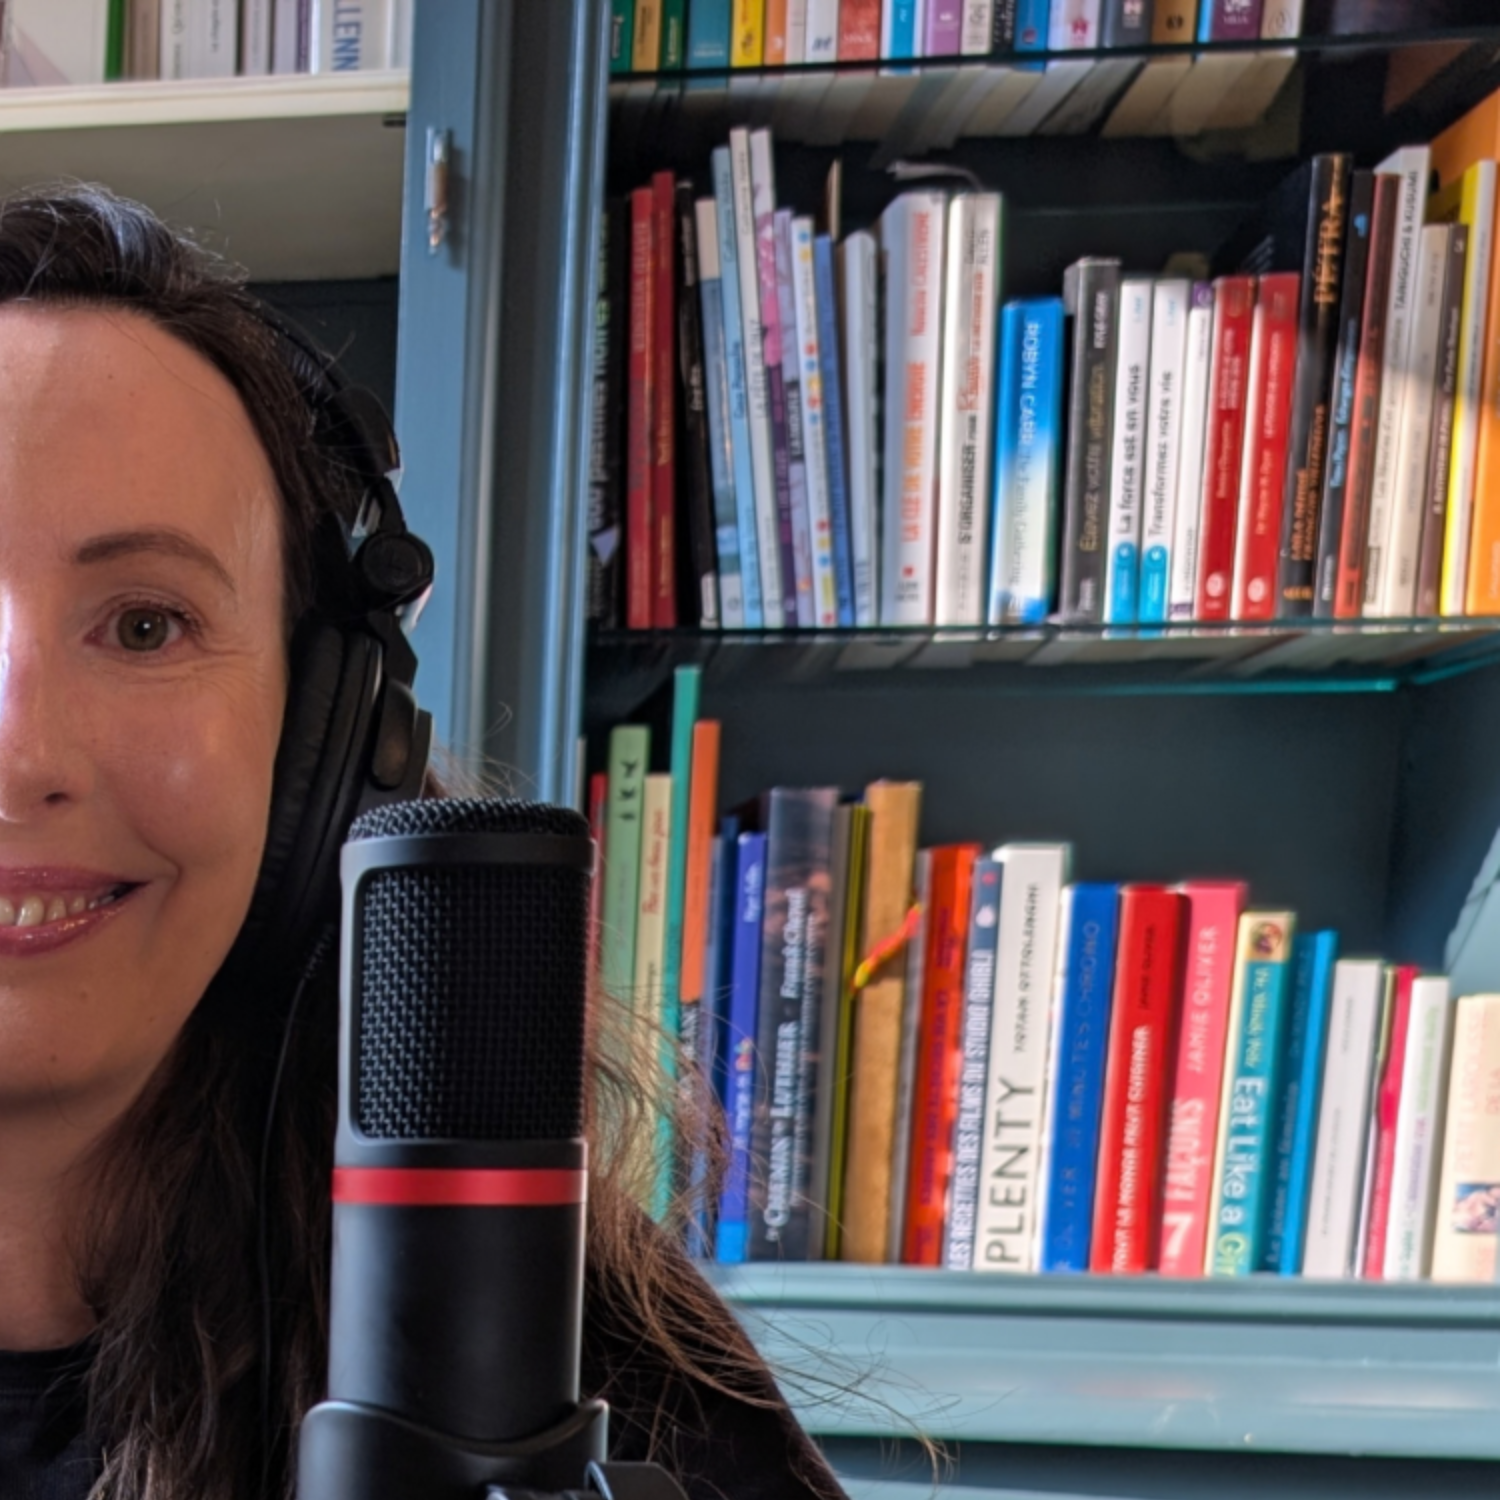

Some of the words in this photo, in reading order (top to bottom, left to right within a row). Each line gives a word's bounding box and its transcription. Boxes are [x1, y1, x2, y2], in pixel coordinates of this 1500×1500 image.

[1402, 170, 1419, 221] KUSUMI
[1394, 237, 1412, 310] TANIGUCHI
[1020, 322, 1040, 387] ROBYN
[1085, 366, 1105, 438] vibration
[1127, 364, 1138, 403] vous
[1157, 371, 1171, 393] vie
[1017, 394, 1037, 445] CARR
[1126, 409, 1137, 430] en
[1157, 398, 1170, 437] votre
[1083, 443, 1102, 488] votre
[1123, 435, 1135, 461] est
[957, 445, 976, 544] S'ORGANISER
[1013, 477, 1029, 517] Family
[1118, 466, 1134, 510] force
[1147, 442, 1167, 535] Transformez
[1074, 491, 1100, 550] Élevez
[1118, 515, 1131, 533] La
[1009, 521, 1027, 586] Gathering
[1016, 882, 1039, 991] OTTOLENGHI
[967, 948, 993, 1001] GHIBLI
[1075, 919, 1100, 1016] CHRONO
[1191, 926, 1218, 1006] OLIVER
[963, 1004, 989, 1056] STUDIO
[1011, 997, 1031, 1053] YOTAM
[1186, 1011, 1210, 1071] JAMIE
[770, 1020, 797, 1117] LUTHIER
[962, 1062, 983, 1080] DU
[1126, 1025, 1150, 1101] CUISINER
[958, 1083, 982, 1130] FILMS
[1122, 1103, 1143, 1146] PEUT
[1230, 1077, 1265, 1128] Eat
[1275, 1080, 1298, 1154] féminin
[956, 1132, 978, 1161] DES
[983, 1074, 1035, 1263] PLENTY
[1165, 1097, 1213, 1200] FAÇONS
[1222, 1136, 1258, 1198] Like
[1275, 1158, 1290, 1180] au
[763, 1136, 793, 1226] CHEMIN
[951, 1164, 976, 1238] RECETTES
[1117, 1148, 1139, 1205] MONDE
[1115, 1208, 1134, 1225] LE
[1161, 1213, 1193, 1257] 7
[1220, 1204, 1240, 1224] a
[949, 1242, 970, 1266] LES
[1264, 1241, 1281, 1262] Le
